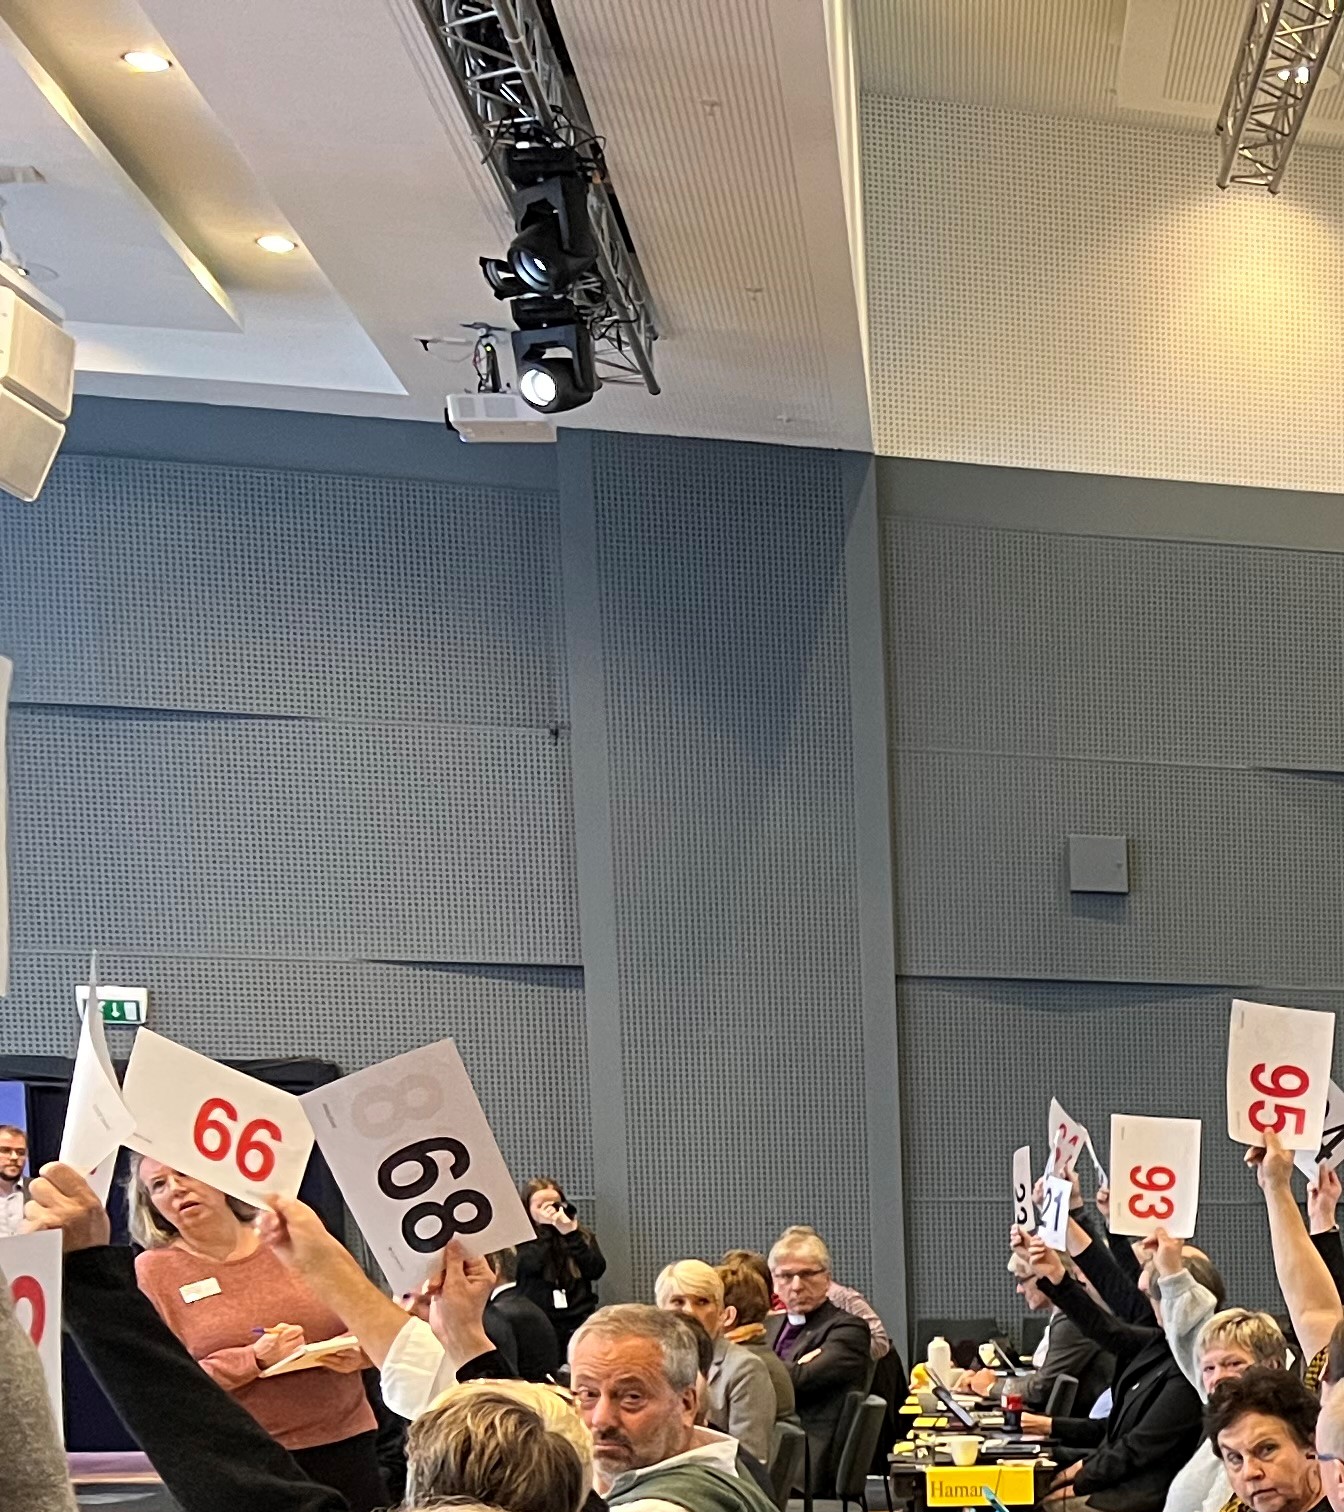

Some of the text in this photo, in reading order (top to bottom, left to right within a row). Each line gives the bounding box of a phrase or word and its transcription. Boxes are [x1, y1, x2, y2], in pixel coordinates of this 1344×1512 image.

[1248, 1063, 1310, 1135] 95
[193, 1097, 283, 1182] 66
[378, 1137, 493, 1254] 68
[1128, 1165, 1176, 1220] 93
